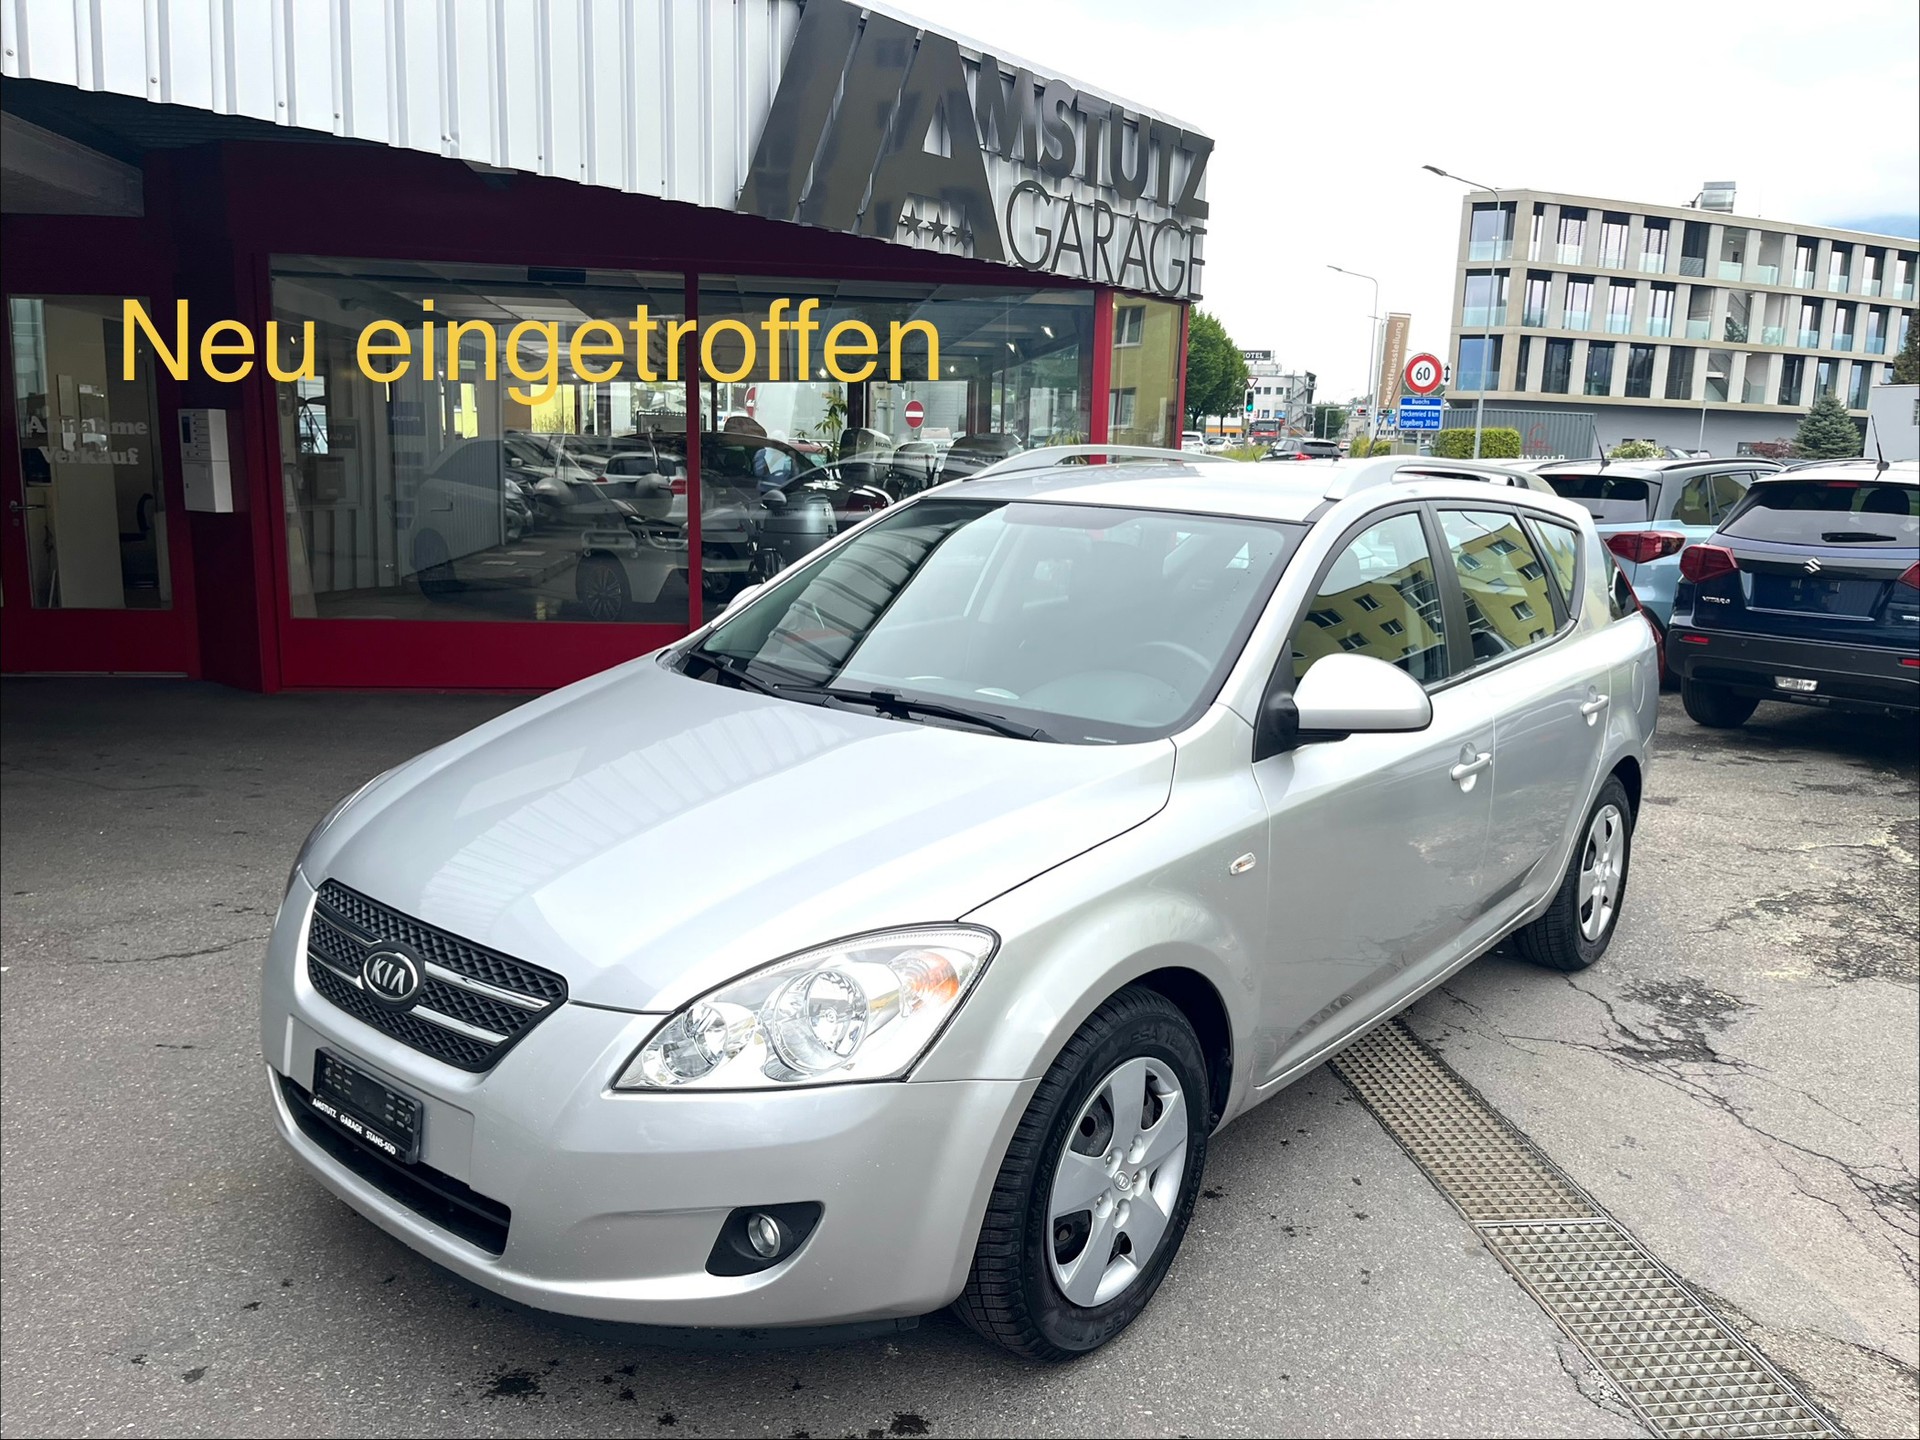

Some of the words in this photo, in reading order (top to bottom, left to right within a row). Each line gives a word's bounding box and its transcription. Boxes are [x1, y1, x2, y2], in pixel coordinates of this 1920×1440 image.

[858, 29, 1215, 262] AMSTUTZ
[1005, 179, 1208, 301] GARAGE
[1384, 321, 1405, 405] Parkettausstellung
[1415, 367, 1431, 381] 60
[26, 415, 148, 435] Anahme
[1400, 419, 1424, 428] Engelberg
[1401, 410, 1427, 418] Beckenried
[37, 445, 140, 466] Verkauf
[370, 958, 406, 995] KIA
[311, 1097, 337, 1119] AMSTUTZ
[339, 1114, 363, 1135] GARAGE
